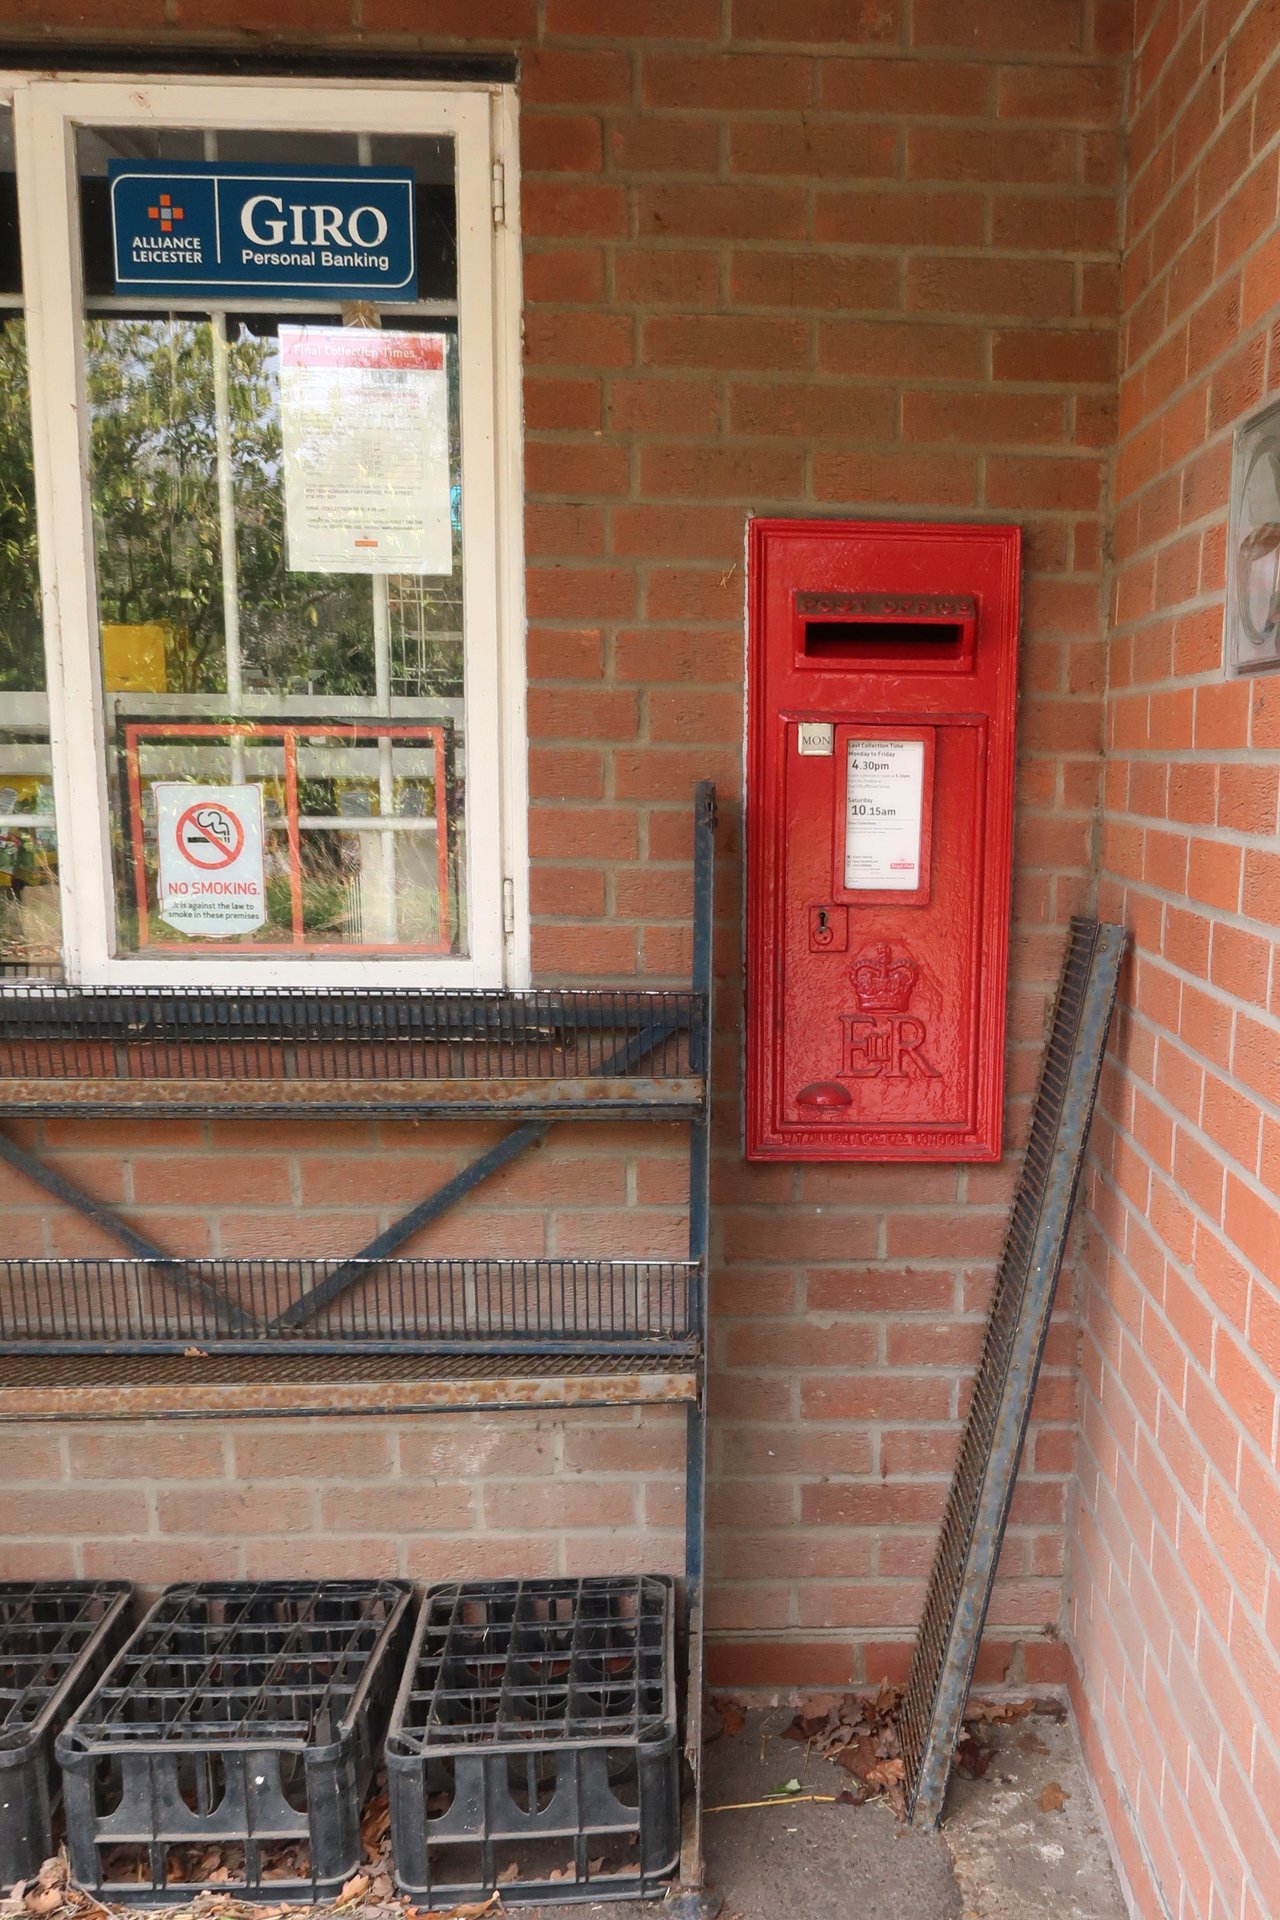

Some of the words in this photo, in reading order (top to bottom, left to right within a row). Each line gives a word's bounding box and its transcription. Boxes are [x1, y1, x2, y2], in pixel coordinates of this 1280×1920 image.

[240, 195, 388, 248] GIRO
[132, 236, 201, 250] ALLIANCE
[132, 250, 203, 264] LEICESTER
[242, 249, 315, 267] Personal
[322, 252, 389, 271] Banking
[294, 344, 322, 355] Final
[326, 345, 377, 358] Collection
[383, 345, 417, 358] Times
[802, 735, 832, 746] MON
[851, 759, 889, 771] 4.30pm
[851, 804, 896, 816] 10.15am
[168, 882, 188, 895] NO
[192, 882, 261, 895] SMOKING.
[188, 903, 216, 911] against
[231, 902, 245, 910] law
[225, 912, 260, 920] premises
